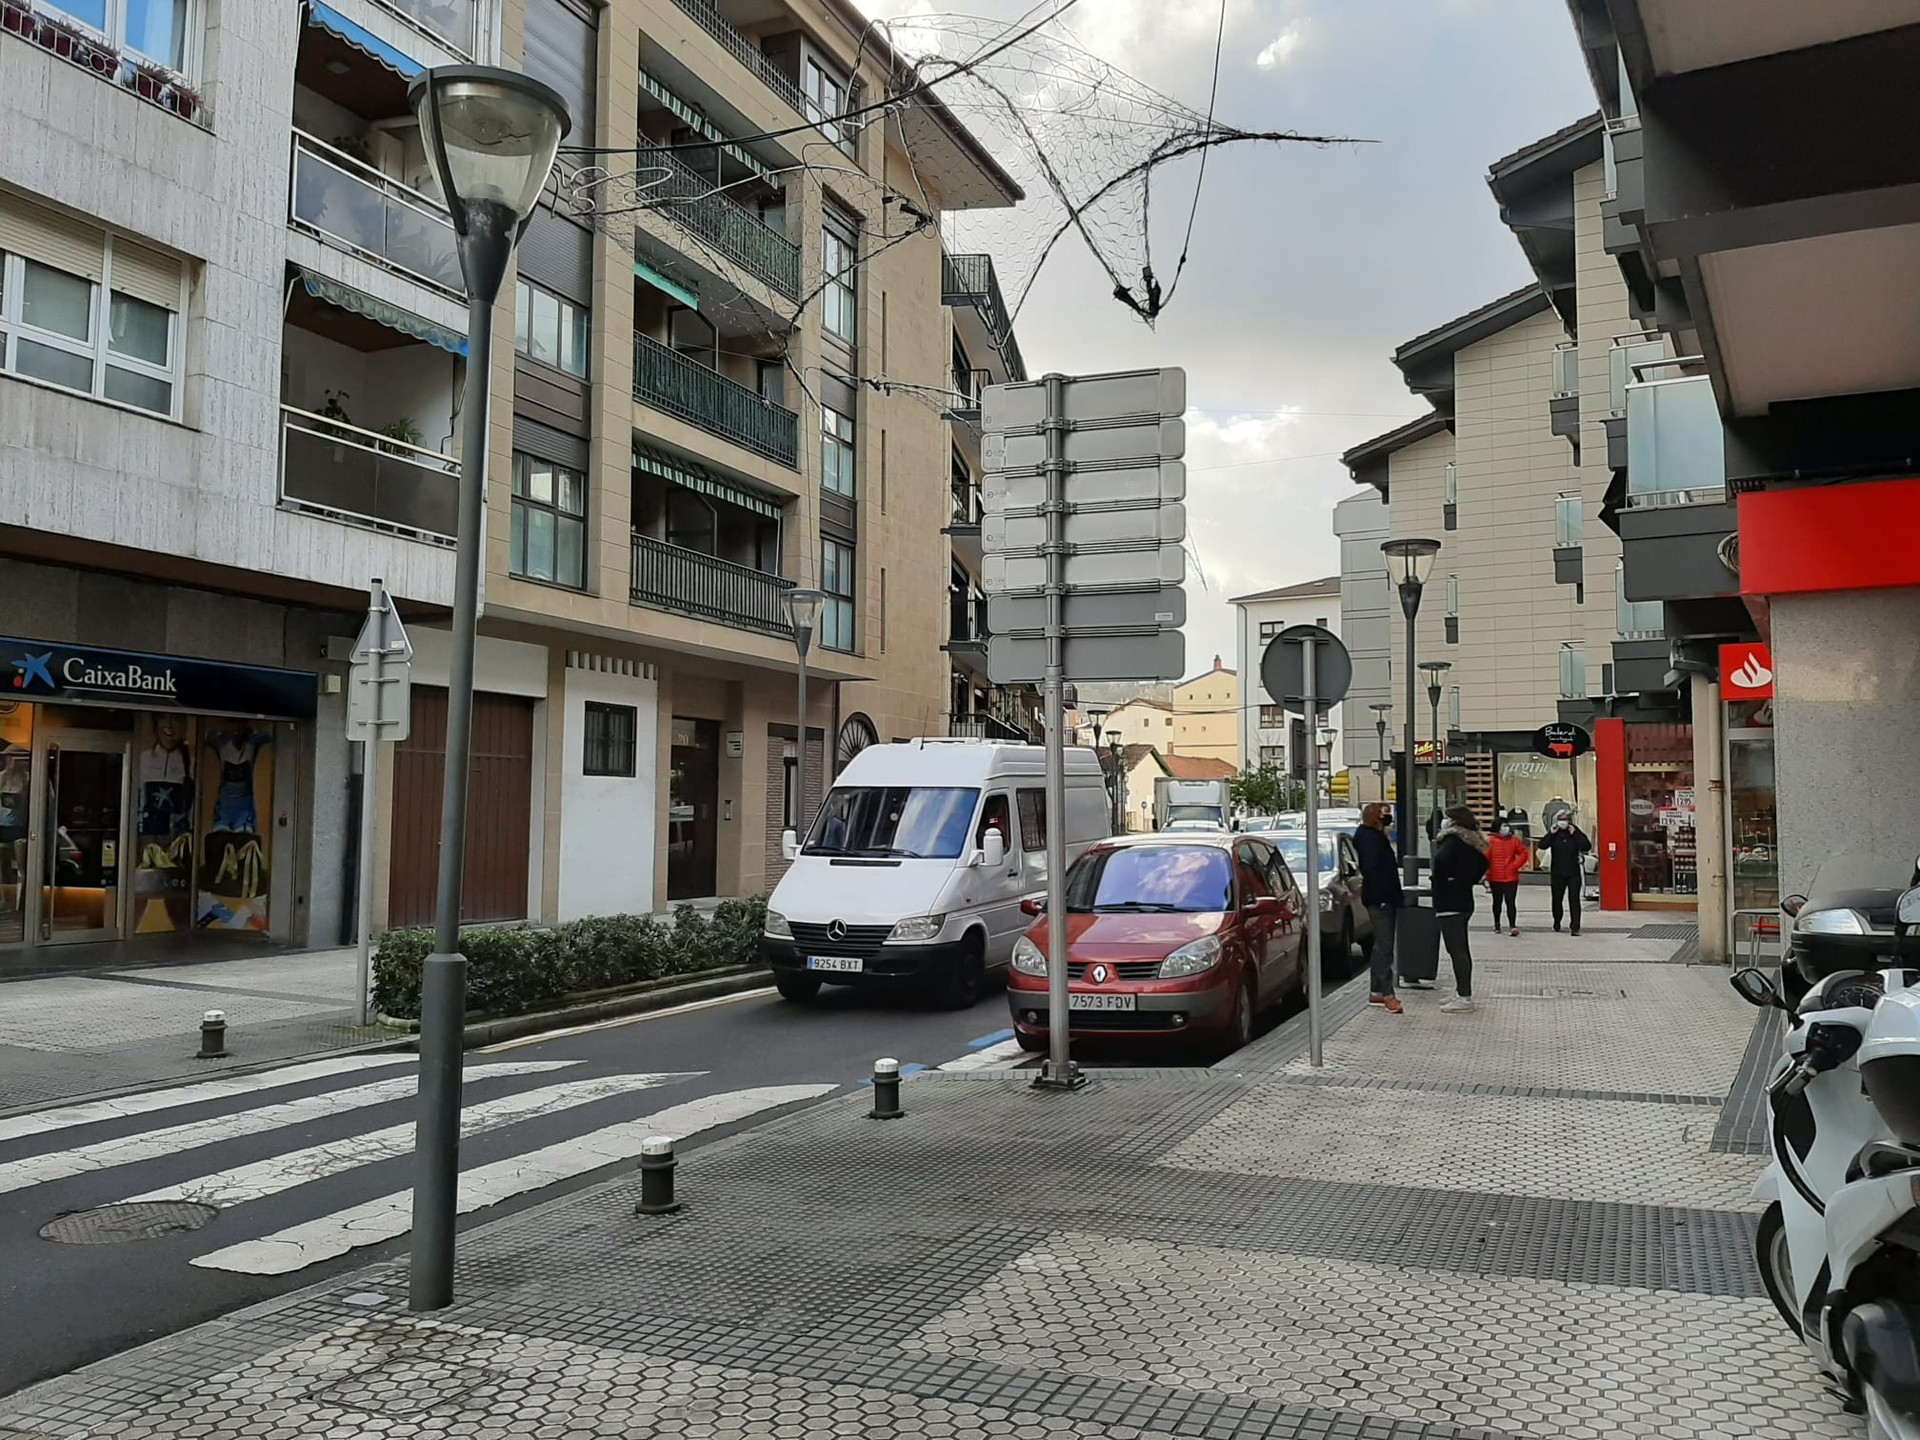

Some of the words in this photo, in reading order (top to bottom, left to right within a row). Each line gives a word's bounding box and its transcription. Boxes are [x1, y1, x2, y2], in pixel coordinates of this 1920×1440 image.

[63, 657, 177, 692] CaixaBank
[814, 958, 837, 969] 9254
[840, 959, 859, 970] BXT
[1072, 995, 1103, 1008] 7573
[1107, 996, 1131, 1009] FDV
